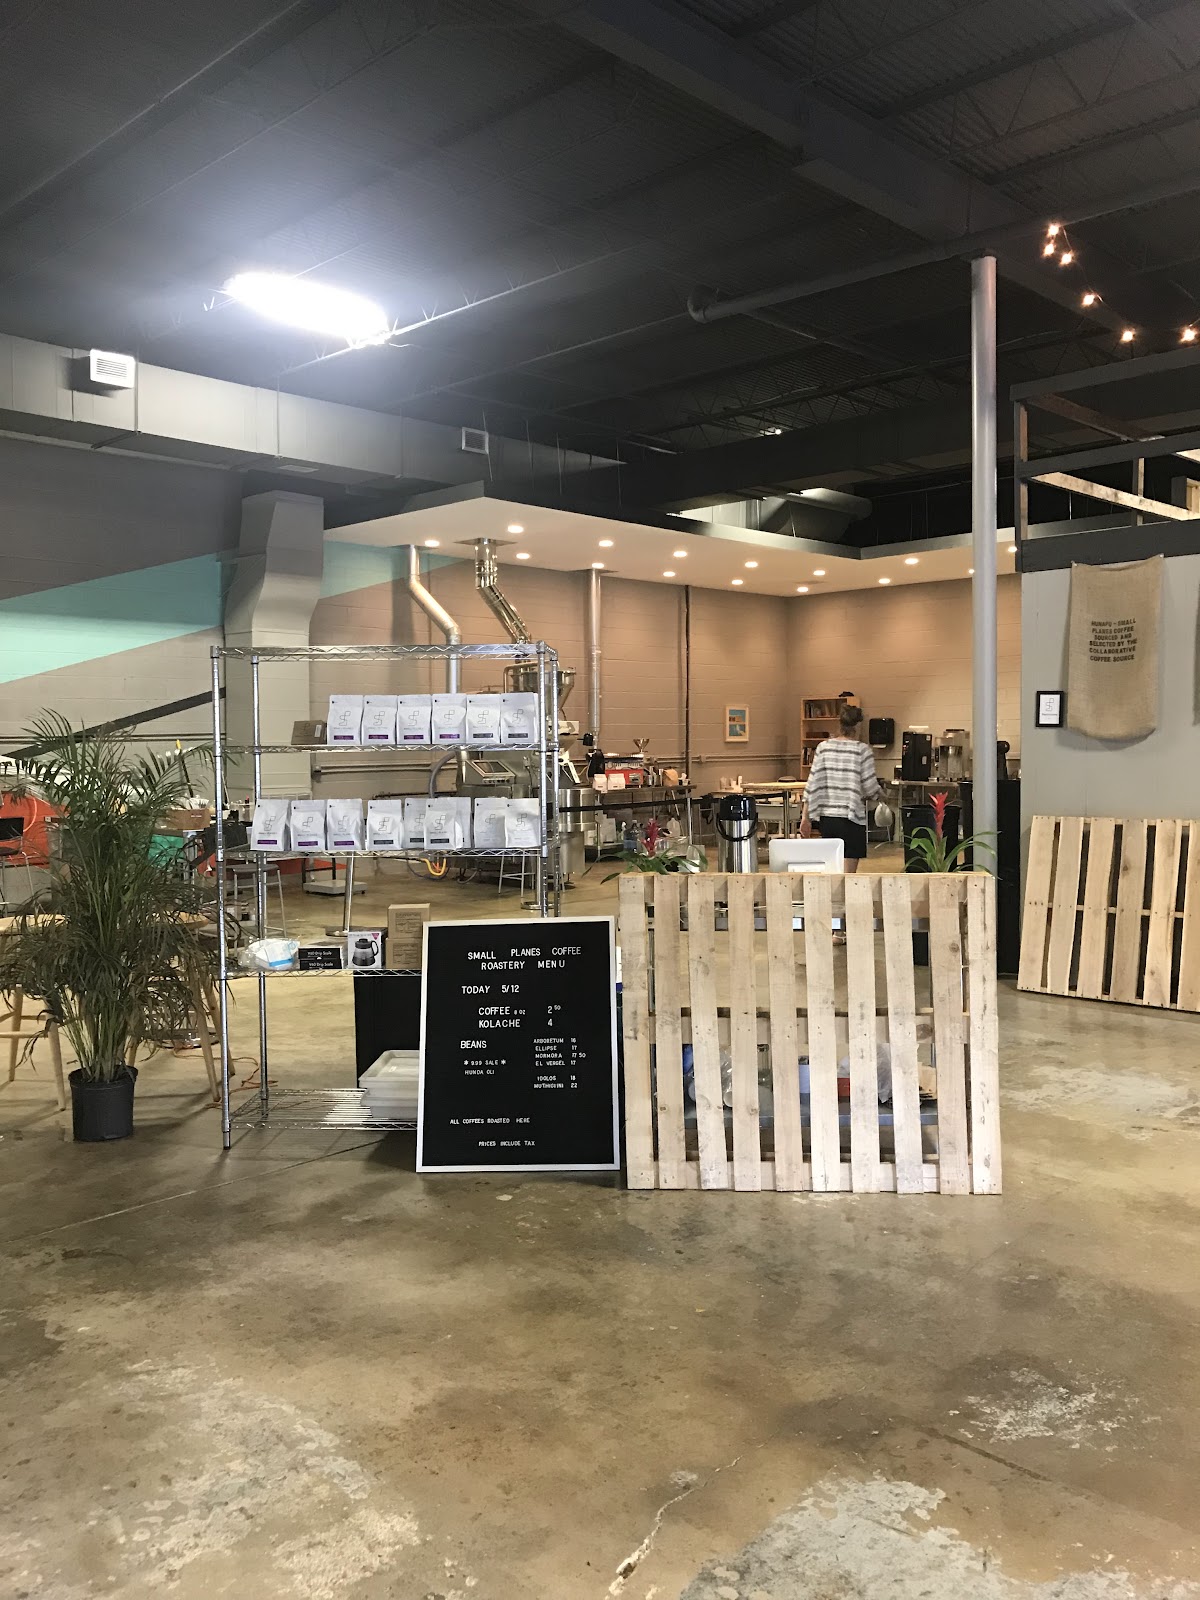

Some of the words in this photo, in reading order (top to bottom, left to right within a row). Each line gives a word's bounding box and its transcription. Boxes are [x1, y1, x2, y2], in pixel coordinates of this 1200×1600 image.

[1117, 618, 1136, 626] SMALL
[1113, 626, 1134, 634] COFFEE
[1089, 646, 1136, 654] COLLABORATIVE
[1112, 654, 1135, 662] SOURCE
[468, 951, 496, 960] SMALL
[511, 948, 540, 956] PLANES
[552, 947, 581, 955] COFFEE
[481, 961, 525, 970] ROASTERY
[538, 960, 565, 968] MENU
[462, 985, 490, 994] TODAY
[502, 985, 519, 993] 5/12
[479, 1006, 510, 1015] COFFEE
[479, 1019, 520, 1028] KOLACHE
[547, 1018, 553, 1027] 4
[461, 1040, 487, 1049] BEANS
